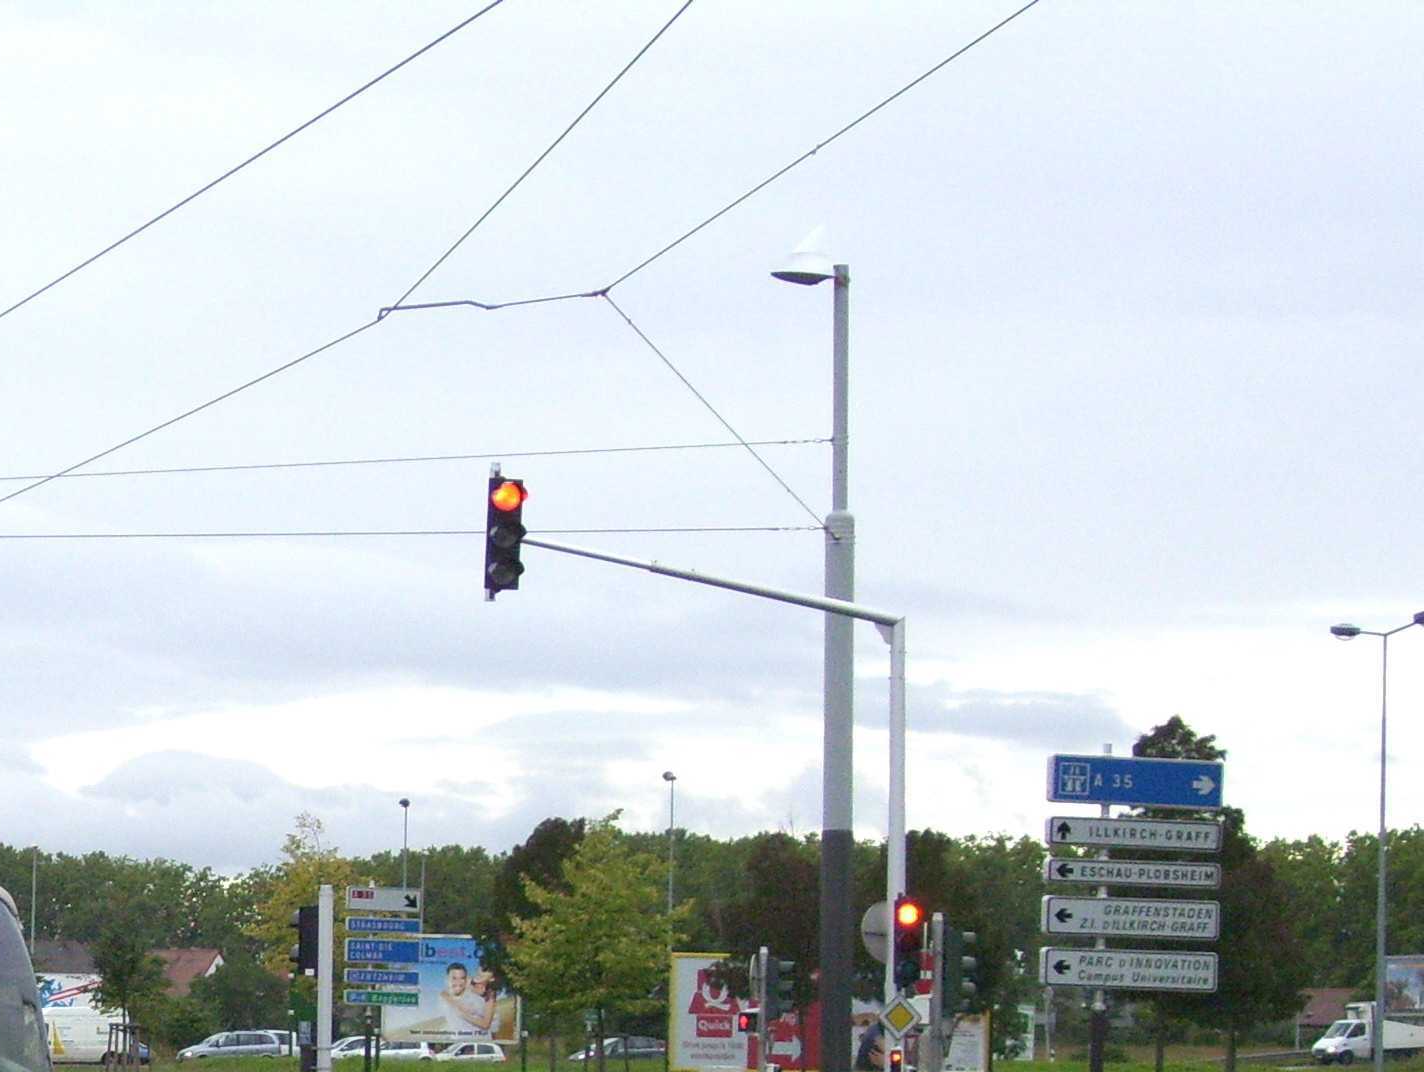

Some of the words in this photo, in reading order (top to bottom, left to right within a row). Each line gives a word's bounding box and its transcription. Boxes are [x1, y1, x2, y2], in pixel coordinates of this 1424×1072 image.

[1094, 773, 1103, 787] A
[1112, 774, 1134, 789] 35
[1088, 825, 1211, 842] ILLKIRCH-GRAFF
[1080, 865, 1215, 882] ESCHAU-PLOBSHEIM
[1103, 904, 1214, 920] GRAFFENSTADEN
[1079, 955, 1113, 967] PARC
[1078, 969, 1125, 983] Campus
[1131, 971, 1209, 987] Universitaire
[698, 1020, 730, 1031] Quick
